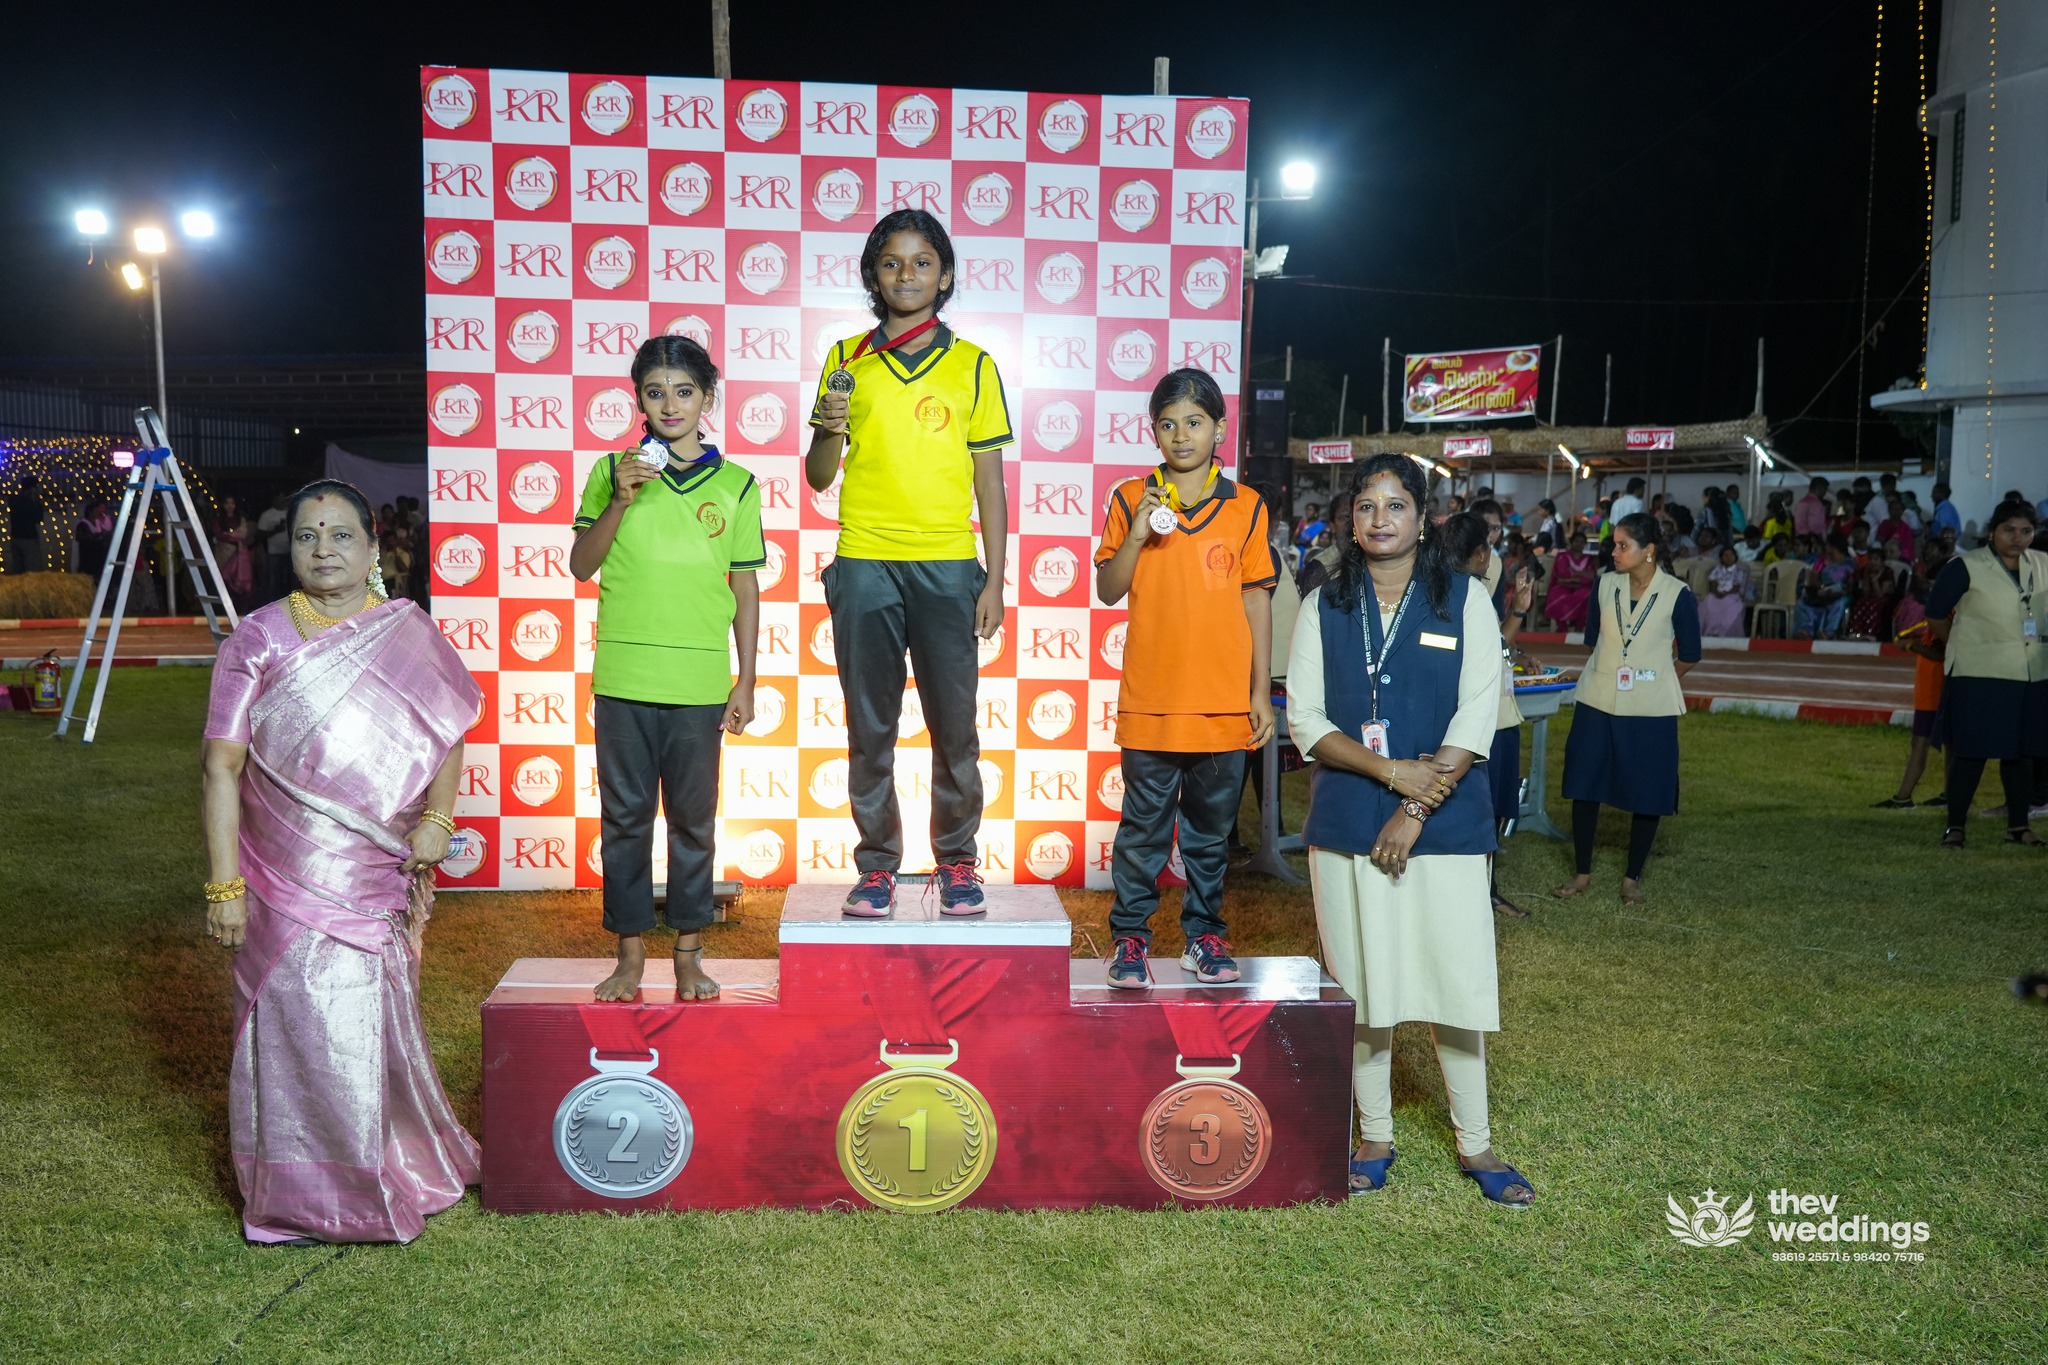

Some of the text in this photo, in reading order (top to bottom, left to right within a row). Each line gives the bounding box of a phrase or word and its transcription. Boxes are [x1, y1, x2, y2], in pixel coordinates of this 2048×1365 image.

[434, 89, 465, 106] RR
[496, 88, 565, 123] RR
[592, 95, 622, 112] RR
[653, 95, 720, 129] RR
[746, 103, 776, 119] RR
[806, 101, 871, 135] RR
[898, 108, 928, 125] RR
[957, 106, 1021, 139] RR
[1048, 114, 1078, 131] RR
[1105, 113, 1172, 149] RR
[1195, 120, 1225, 136] RR
[424, 162, 488, 197] RR
[516, 171, 546, 187] RR
[576, 169, 643, 203] RR
[670, 176, 700, 193] RR
[729, 176, 796, 209] RR
[822, 182, 853, 199] RR
[972, 187, 1002, 203] RR
[1030, 186, 1094, 220] RR
[1119, 193, 1149, 210] RR
[1176, 192, 1239, 225] RR
[439, 245, 469, 261] RR
[499, 243, 567, 277] RR
[594, 250, 624, 267] RR
[654, 249, 720, 282] RR
[747, 256, 777, 273] RR
[957, 258, 1020, 292] RR
[1102, 264, 1165, 298] RR
[426, 317, 490, 351] RR
[517, 324, 548, 341] RR
[577, 322, 641, 356] RR
[730, 327, 795, 360] RR
[440, 397, 470, 414] RR
[501, 396, 567, 429] RR
[594, 401, 625, 418] RR
[1312, 444, 1352, 458] CASHIER
[429, 469, 493, 503] RR
[519, 475, 549, 491] RR
[1025, 484, 1086, 515] RR
[444, 547, 474, 564] RR
[504, 545, 569, 578] RR
[520, 623, 551, 640] RR
[1023, 628, 1083, 660] RR
[1366, 651, 1372, 663] RR
[1380, 648, 1388, 661] RR
[504, 693, 570, 724] RR
[1022, 770, 1082, 800] RR
[505, 837, 571, 869] RR
[607, 1109, 640, 1163] 2
[898, 1109, 928, 1172] 1
[1189, 1113, 1222, 1165] 3
